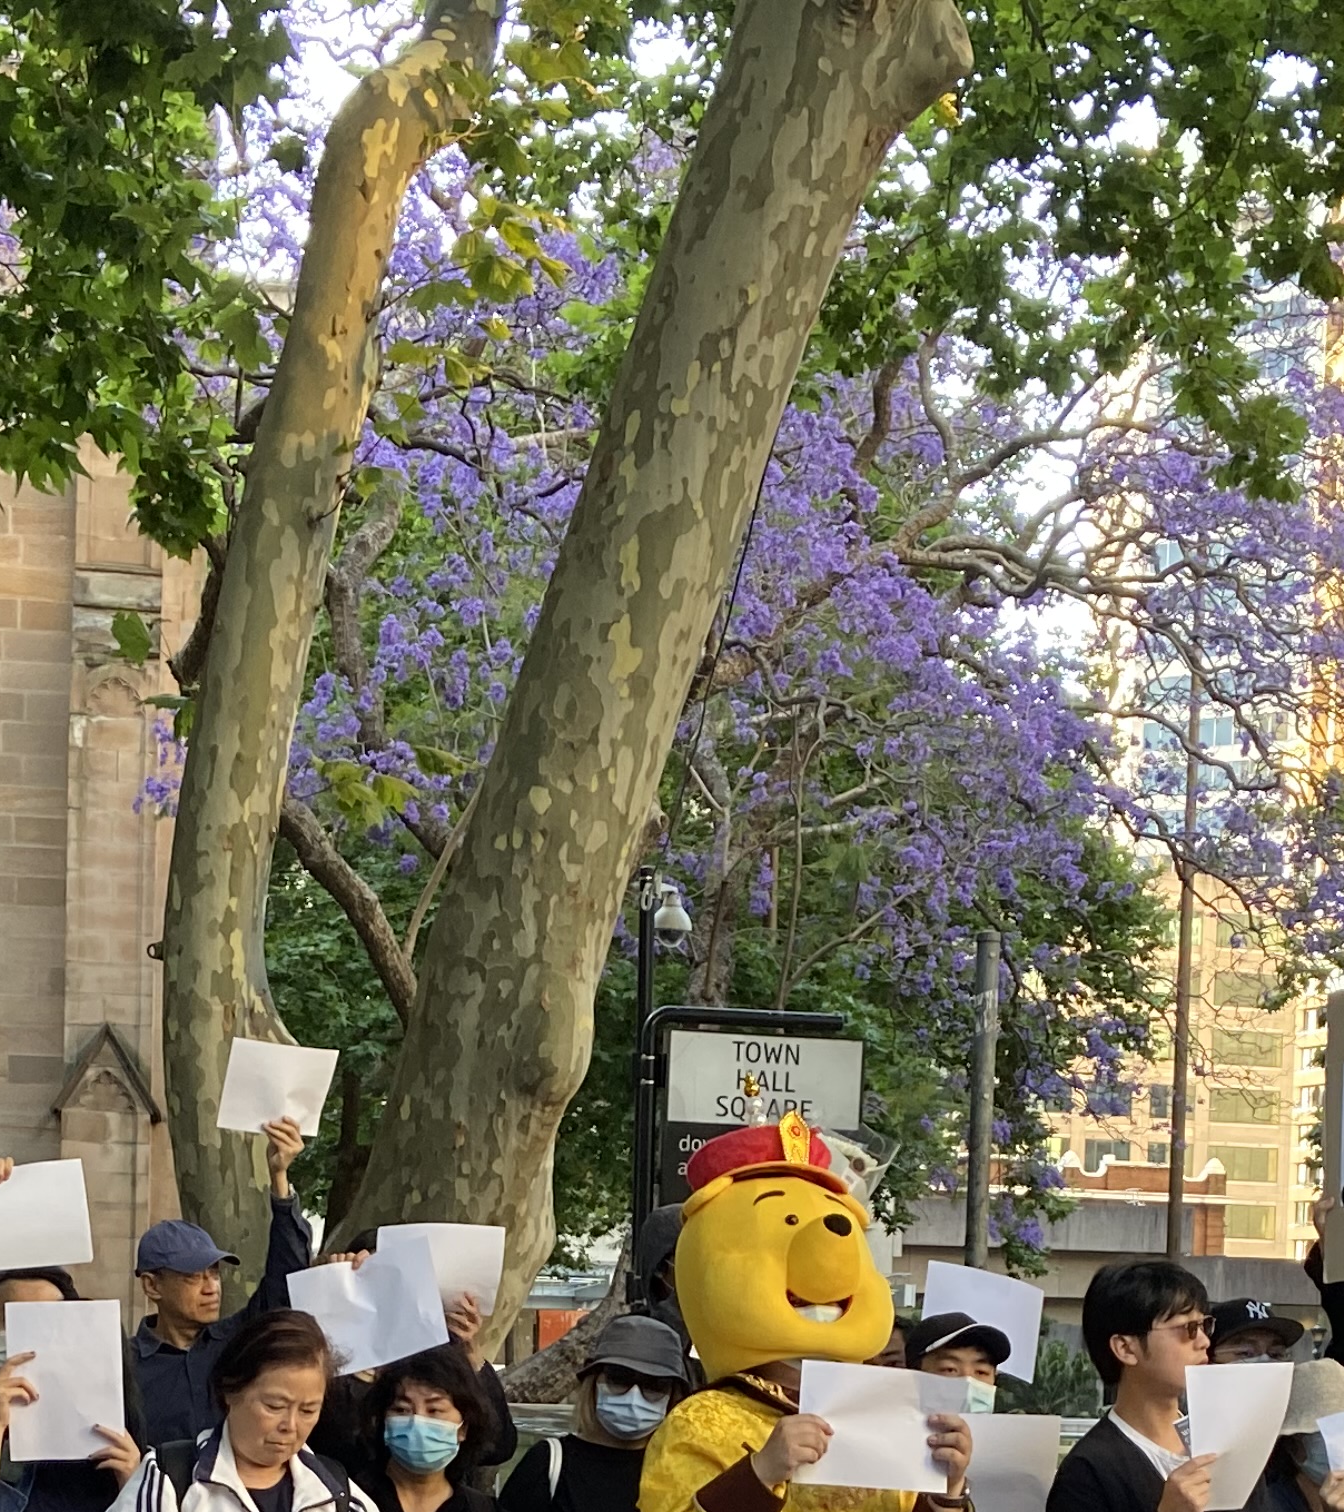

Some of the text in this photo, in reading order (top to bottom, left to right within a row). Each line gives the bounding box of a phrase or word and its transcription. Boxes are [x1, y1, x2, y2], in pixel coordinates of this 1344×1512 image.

[732, 1041, 800, 1066] TOWN
[715, 1096, 813, 1120] SQARE
[1246, 1301, 1272, 1319] NY
